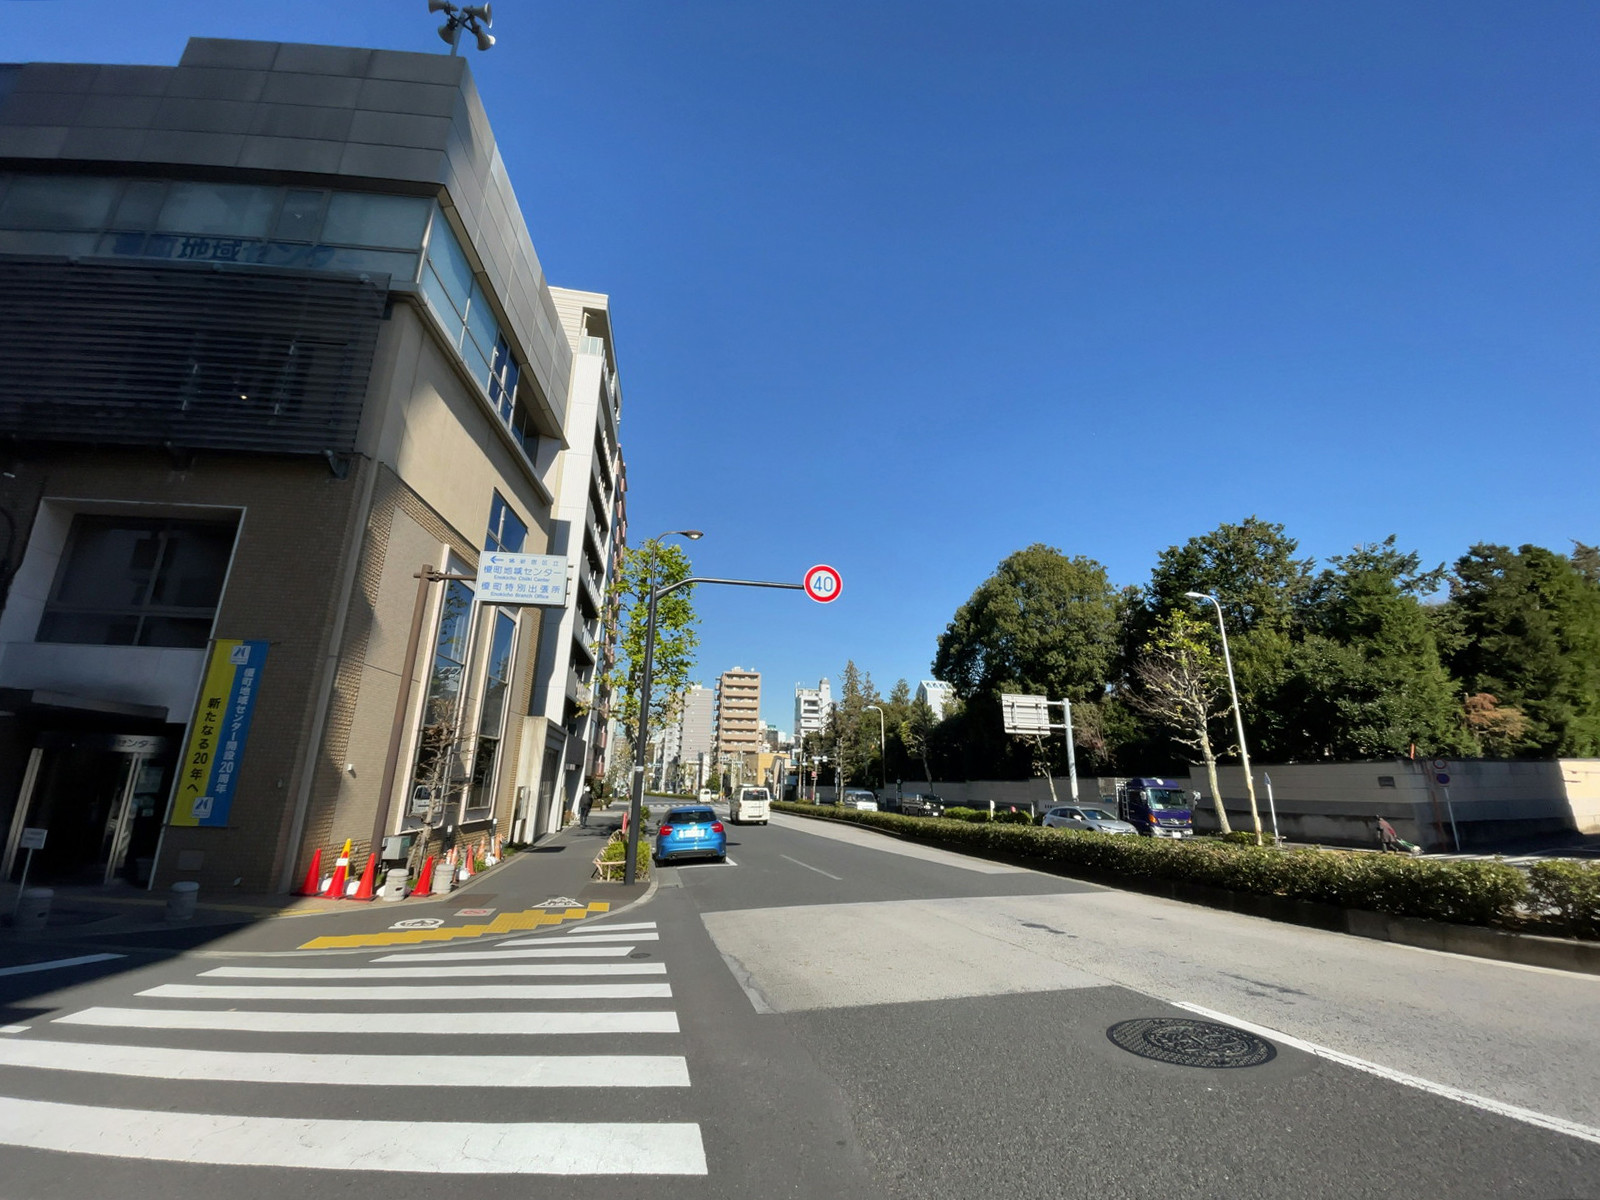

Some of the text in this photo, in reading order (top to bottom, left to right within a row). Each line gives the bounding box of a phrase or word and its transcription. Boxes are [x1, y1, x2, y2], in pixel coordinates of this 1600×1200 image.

[484, 565, 561, 576] 榎町地域センター
[481, 581, 560, 593] 榎町特別出張所
[813, 576, 833, 592] 40
[186, 697, 222, 792] 新たなる20年へ
